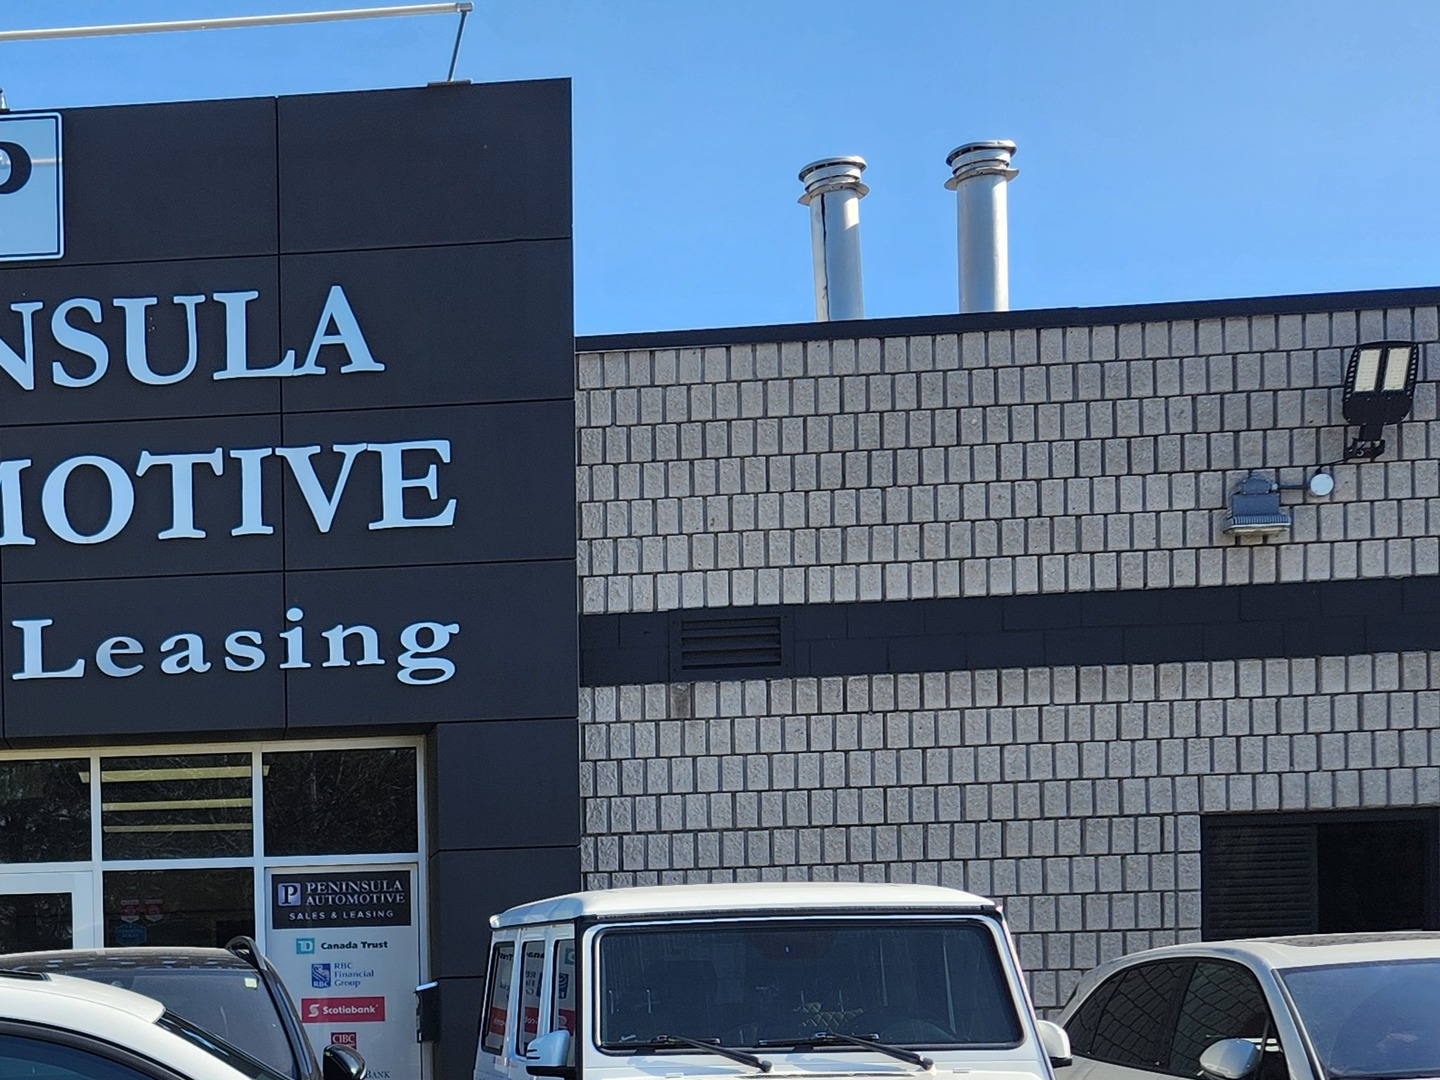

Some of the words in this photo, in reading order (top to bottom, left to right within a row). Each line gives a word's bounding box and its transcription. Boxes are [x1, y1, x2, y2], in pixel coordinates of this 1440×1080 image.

[12, 608, 459, 684] Leasing
[306, 880, 403, 894] PENINSULA
[281, 884, 298, 904] P
[305, 892, 405, 906] AUTOMOTIVE
[289, 911, 325, 920] SALES
[330, 911, 337, 919] &
[343, 909, 394, 919] LEASING
[297, 940, 313, 952] TD
[320, 941, 358, 950] Canada
[361, 940, 388, 949] Trust
[334, 969, 374, 978] Financial
[334, 980, 361, 988] Group
[322, 1005, 376, 1015] Scotiabank
[332, 1033, 355, 1044] CIBC
